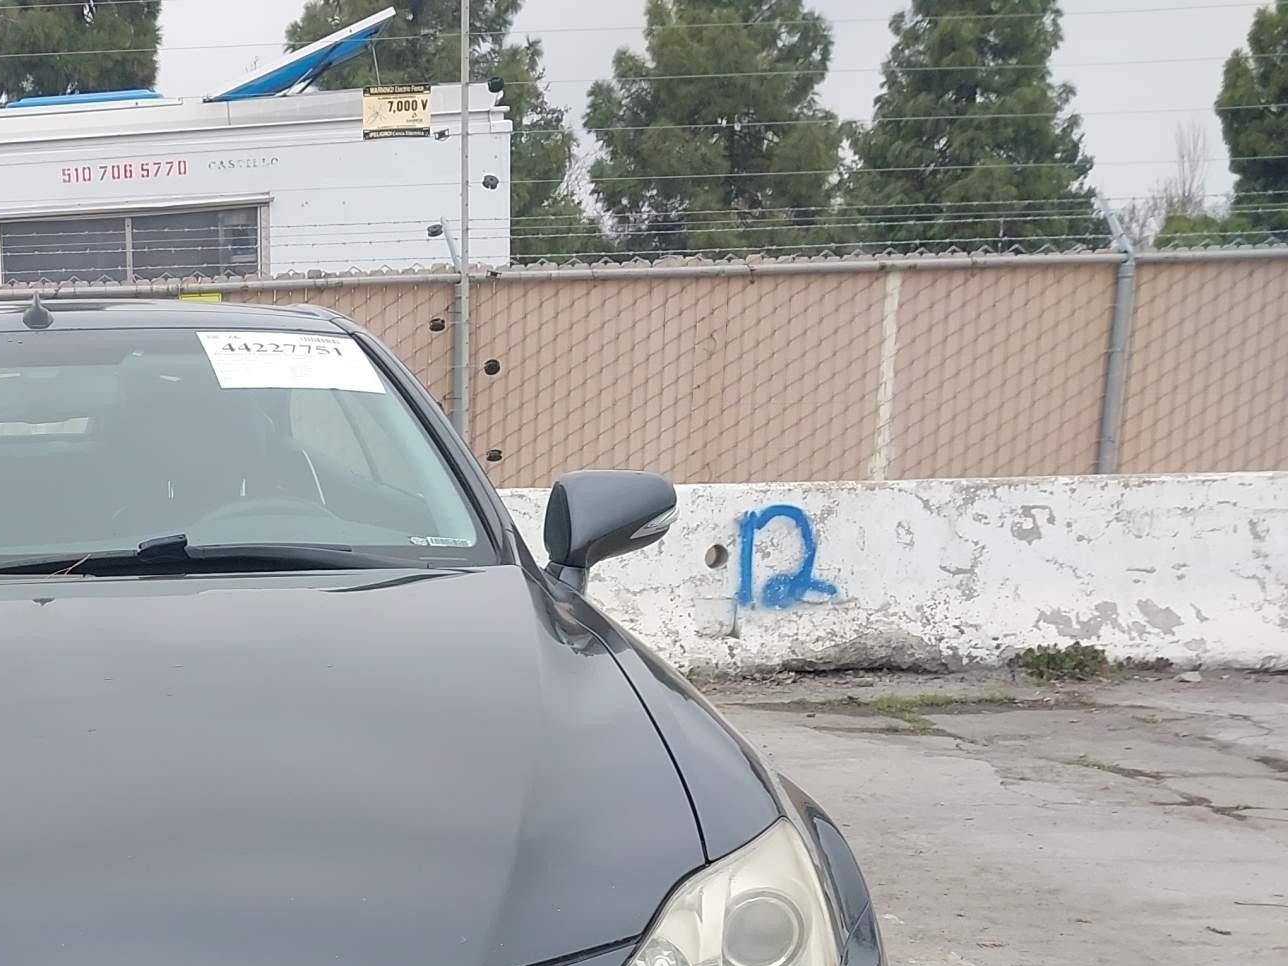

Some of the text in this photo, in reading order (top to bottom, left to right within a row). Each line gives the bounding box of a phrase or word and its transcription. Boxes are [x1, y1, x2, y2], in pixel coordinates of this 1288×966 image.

[387, 98, 428, 114] 7,000 V
[62, 160, 187, 183] 510 706 5770
[221, 342, 344, 357] 44227751
[738, 505, 838, 609] 12
